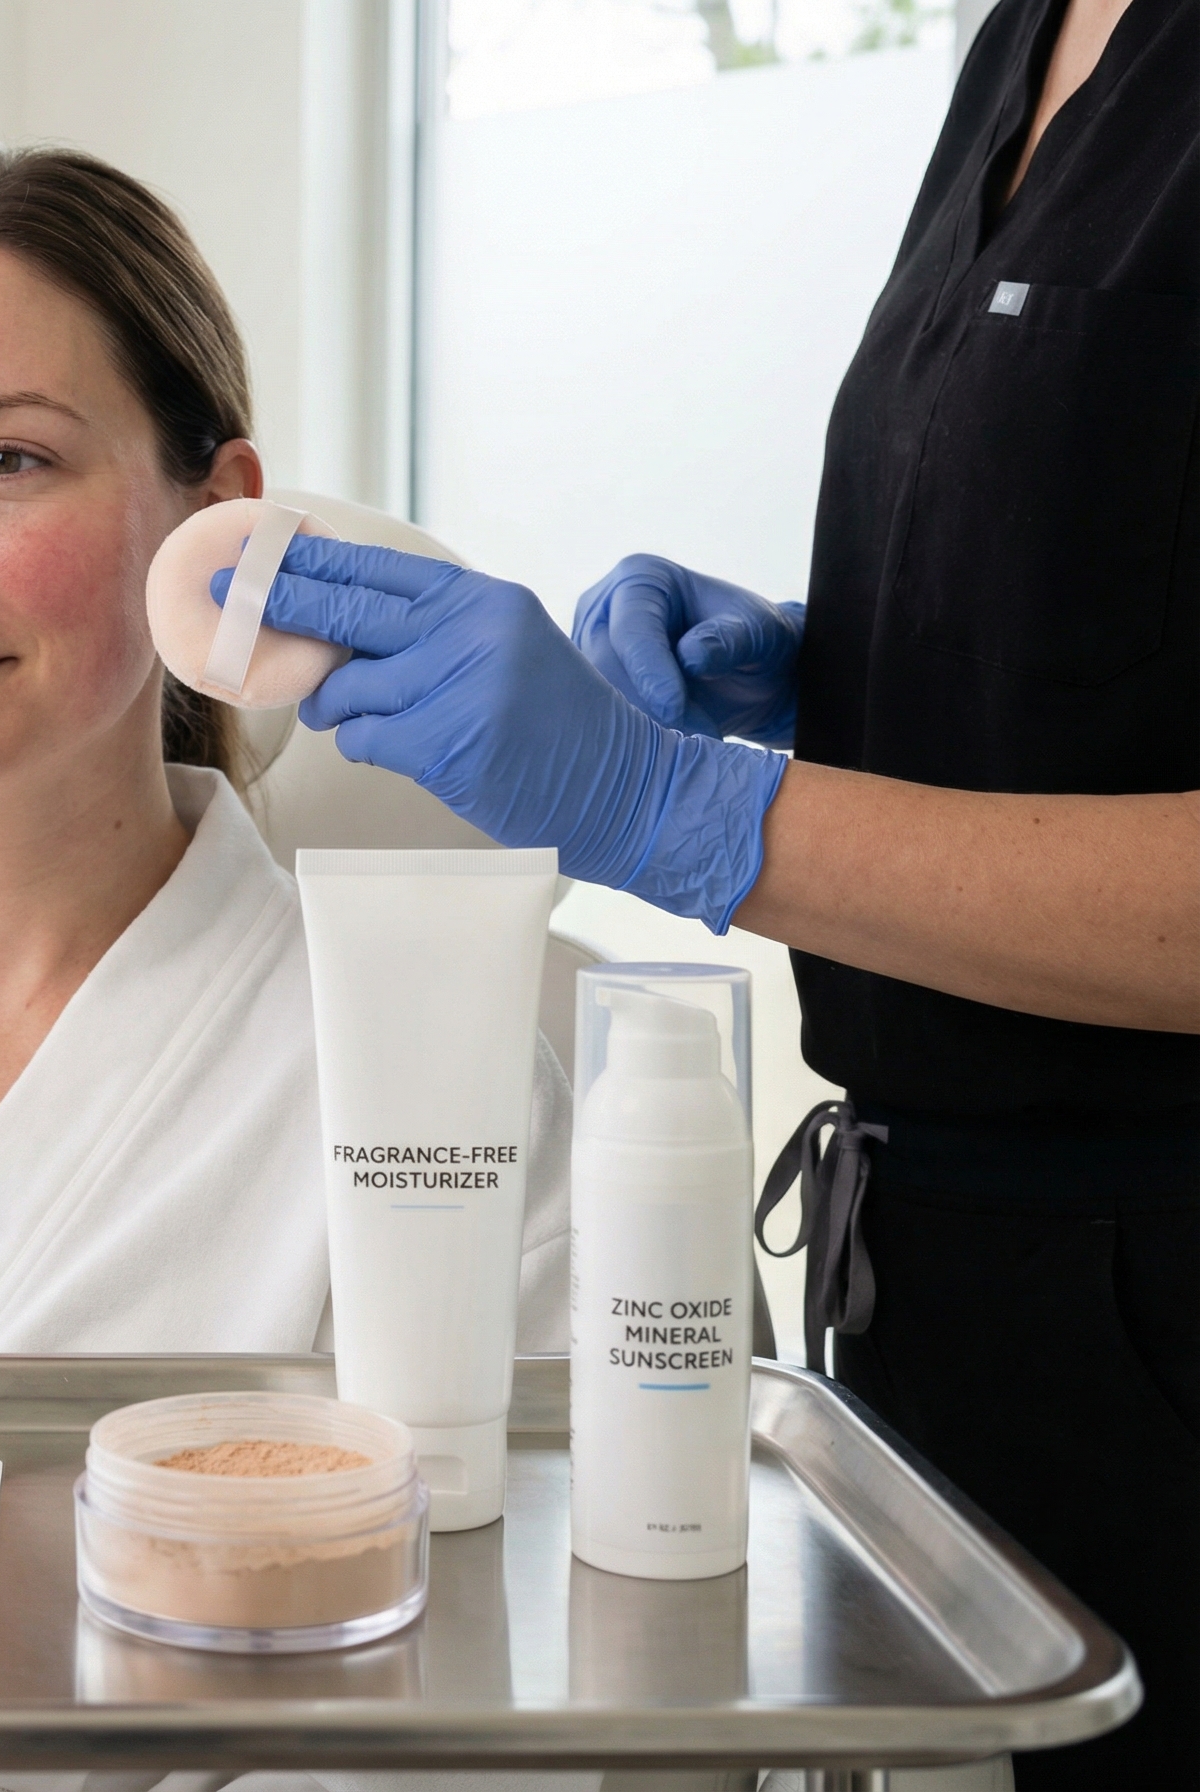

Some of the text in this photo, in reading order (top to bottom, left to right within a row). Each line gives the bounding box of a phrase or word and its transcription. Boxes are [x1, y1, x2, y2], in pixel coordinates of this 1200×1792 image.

[333, 1145, 518, 1164] FRAGRANCE-FREE
[353, 1171, 499, 1188] MOISTURIZER
[611, 1298, 732, 1319] ZINC OXIDE
[625, 1325, 722, 1345] MINERAL
[609, 1348, 733, 1370] SUNSCREEN
